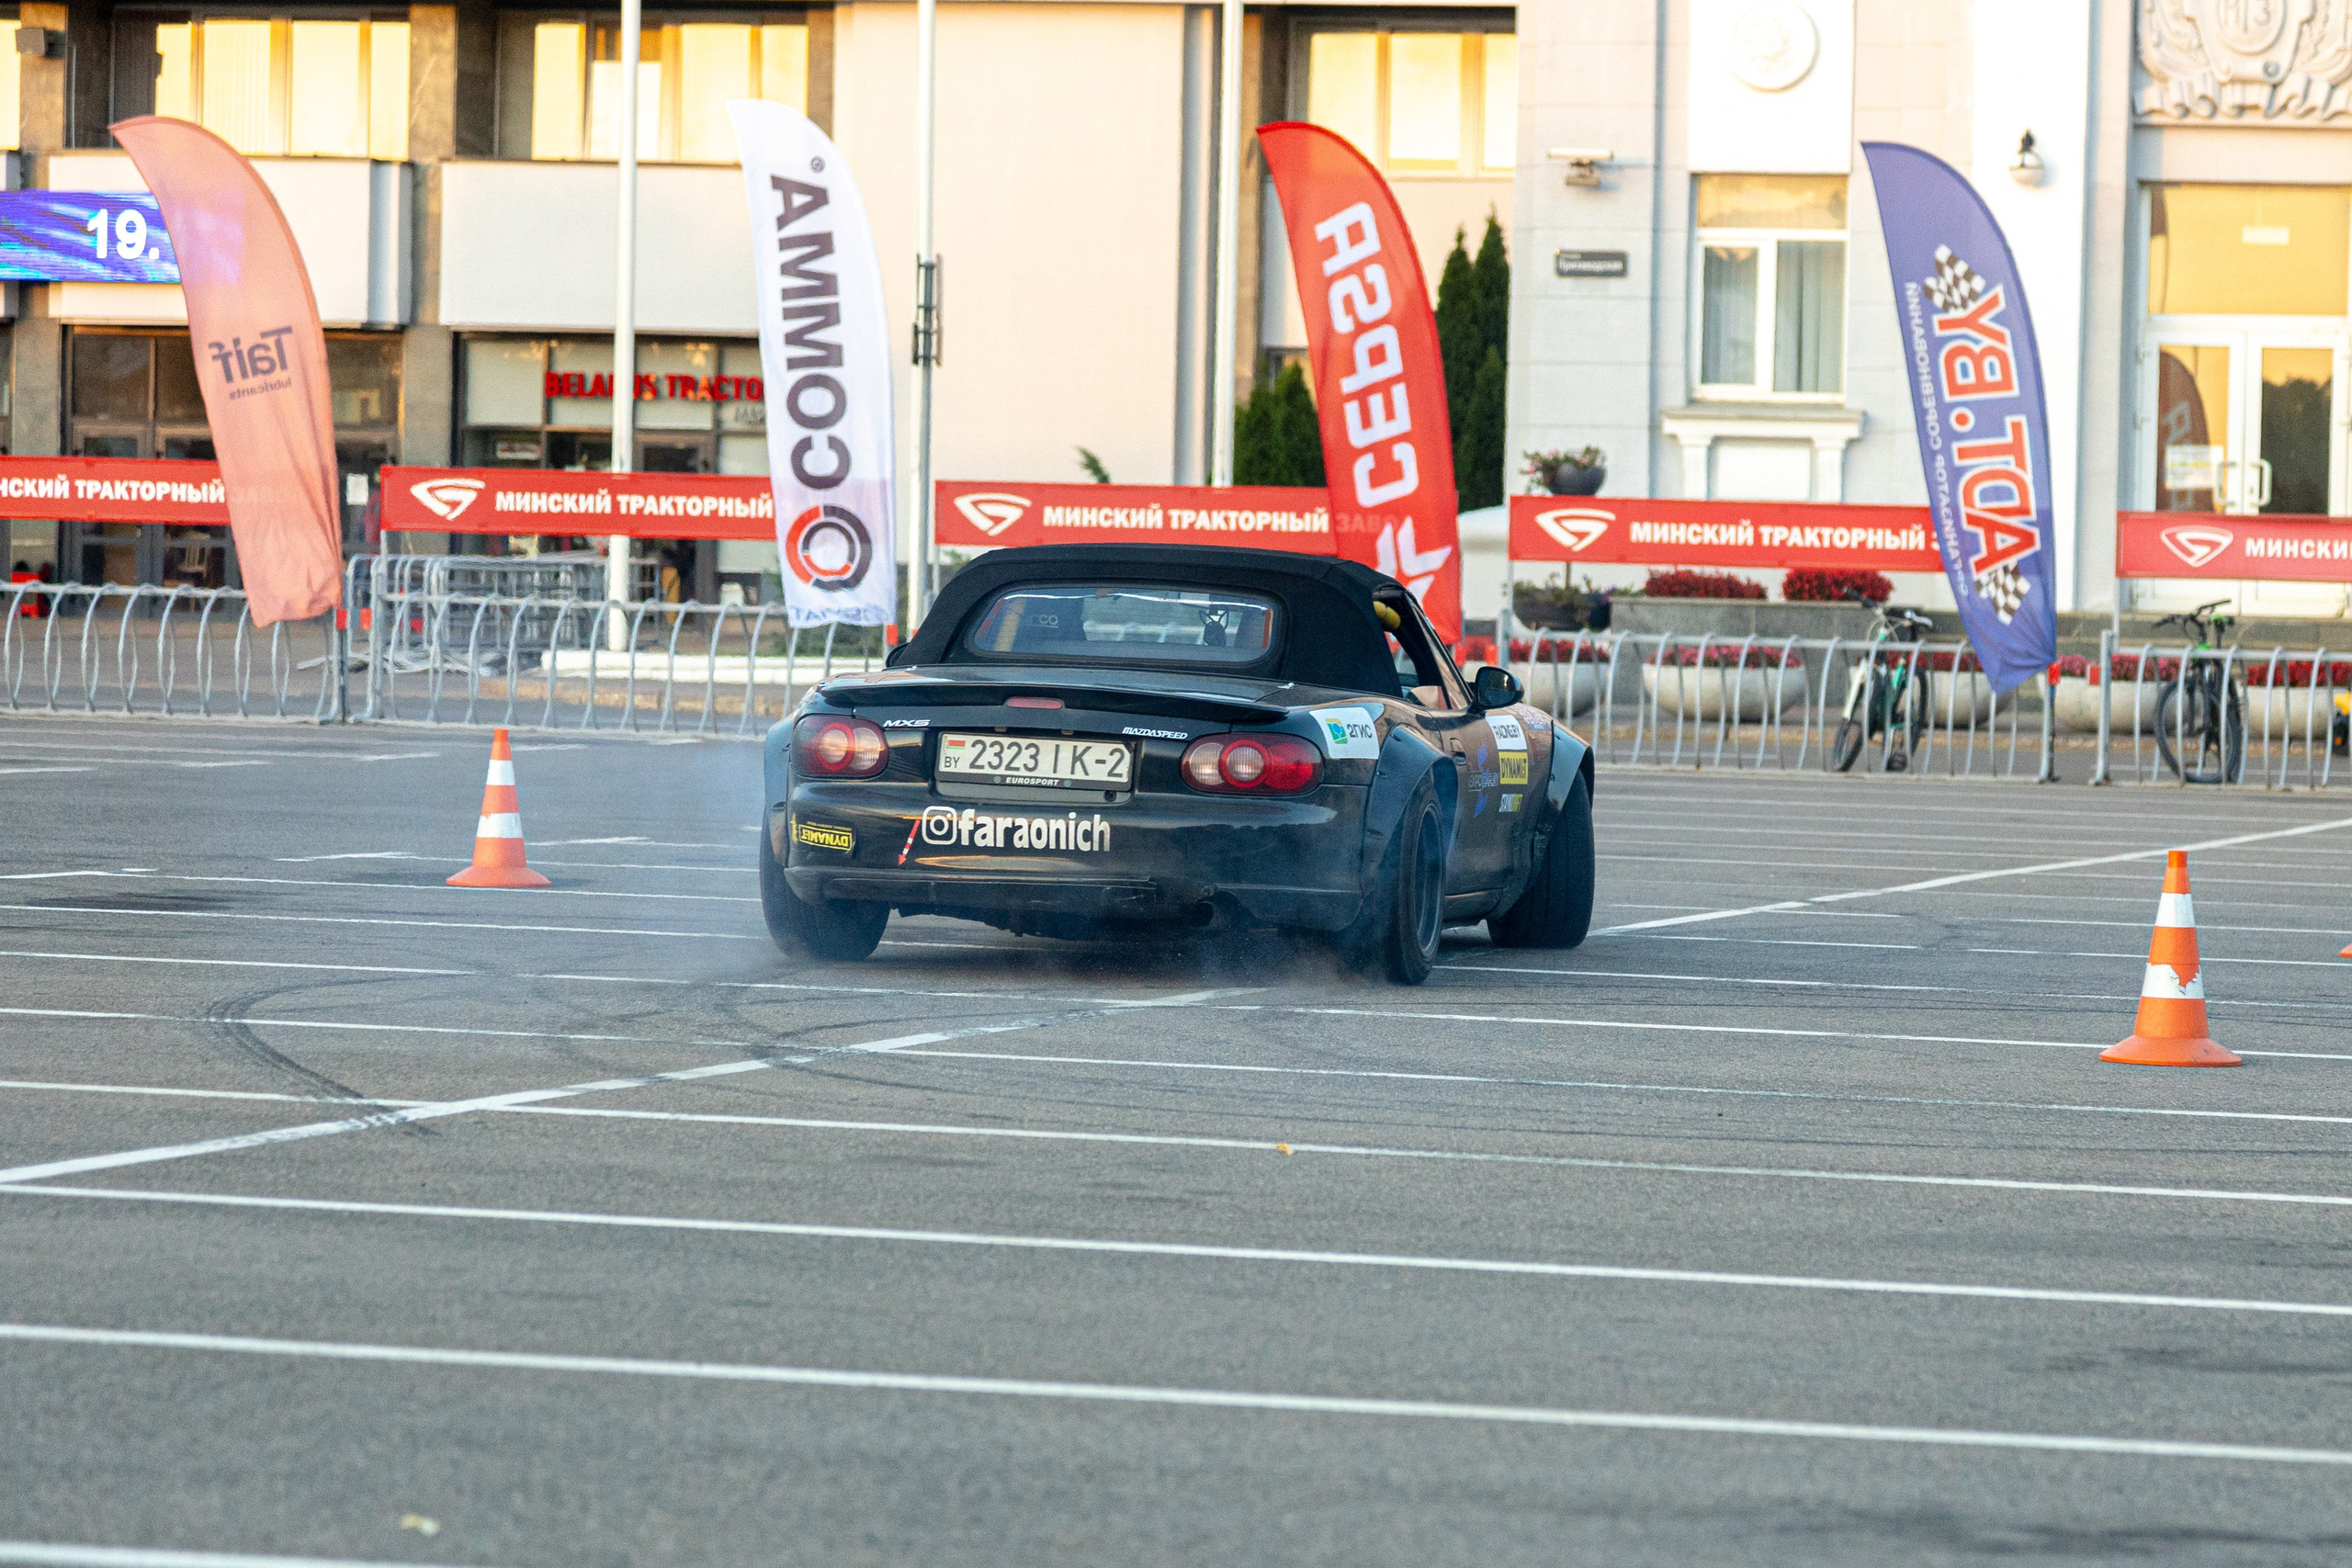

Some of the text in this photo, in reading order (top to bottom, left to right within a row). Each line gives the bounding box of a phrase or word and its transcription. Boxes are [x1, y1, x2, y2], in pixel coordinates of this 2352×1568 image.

[87, 209, 160, 260] 19.
[665, 373, 764, 402] TRACTO
[74, 478, 225, 504] ТРАКТОРНЫЙ
[495, 489, 774, 519] МИНСКИЙ ТРАКТОРНЫЙ
[1042, 502, 1163, 530] МИНСКИЙ
[1169, 507, 1329, 534] ТРАКТОРНЫЙ
[1630, 519, 1755, 547] МИНСКИЙ
[1759, 524, 1926, 551] ТРАКТОРНЫЙ
[2245, 538, 2352, 559] МИНСКИ
[1122, 727, 1189, 740] MAZDASPEED
[1346, 724, 1374, 739] 2ГИС
[944, 756, 961, 769] BY
[968, 739, 1040, 773] 2323
[1005, 776, 1060, 787] EUROSPORT
[958, 808, 1111, 852] faraonich
